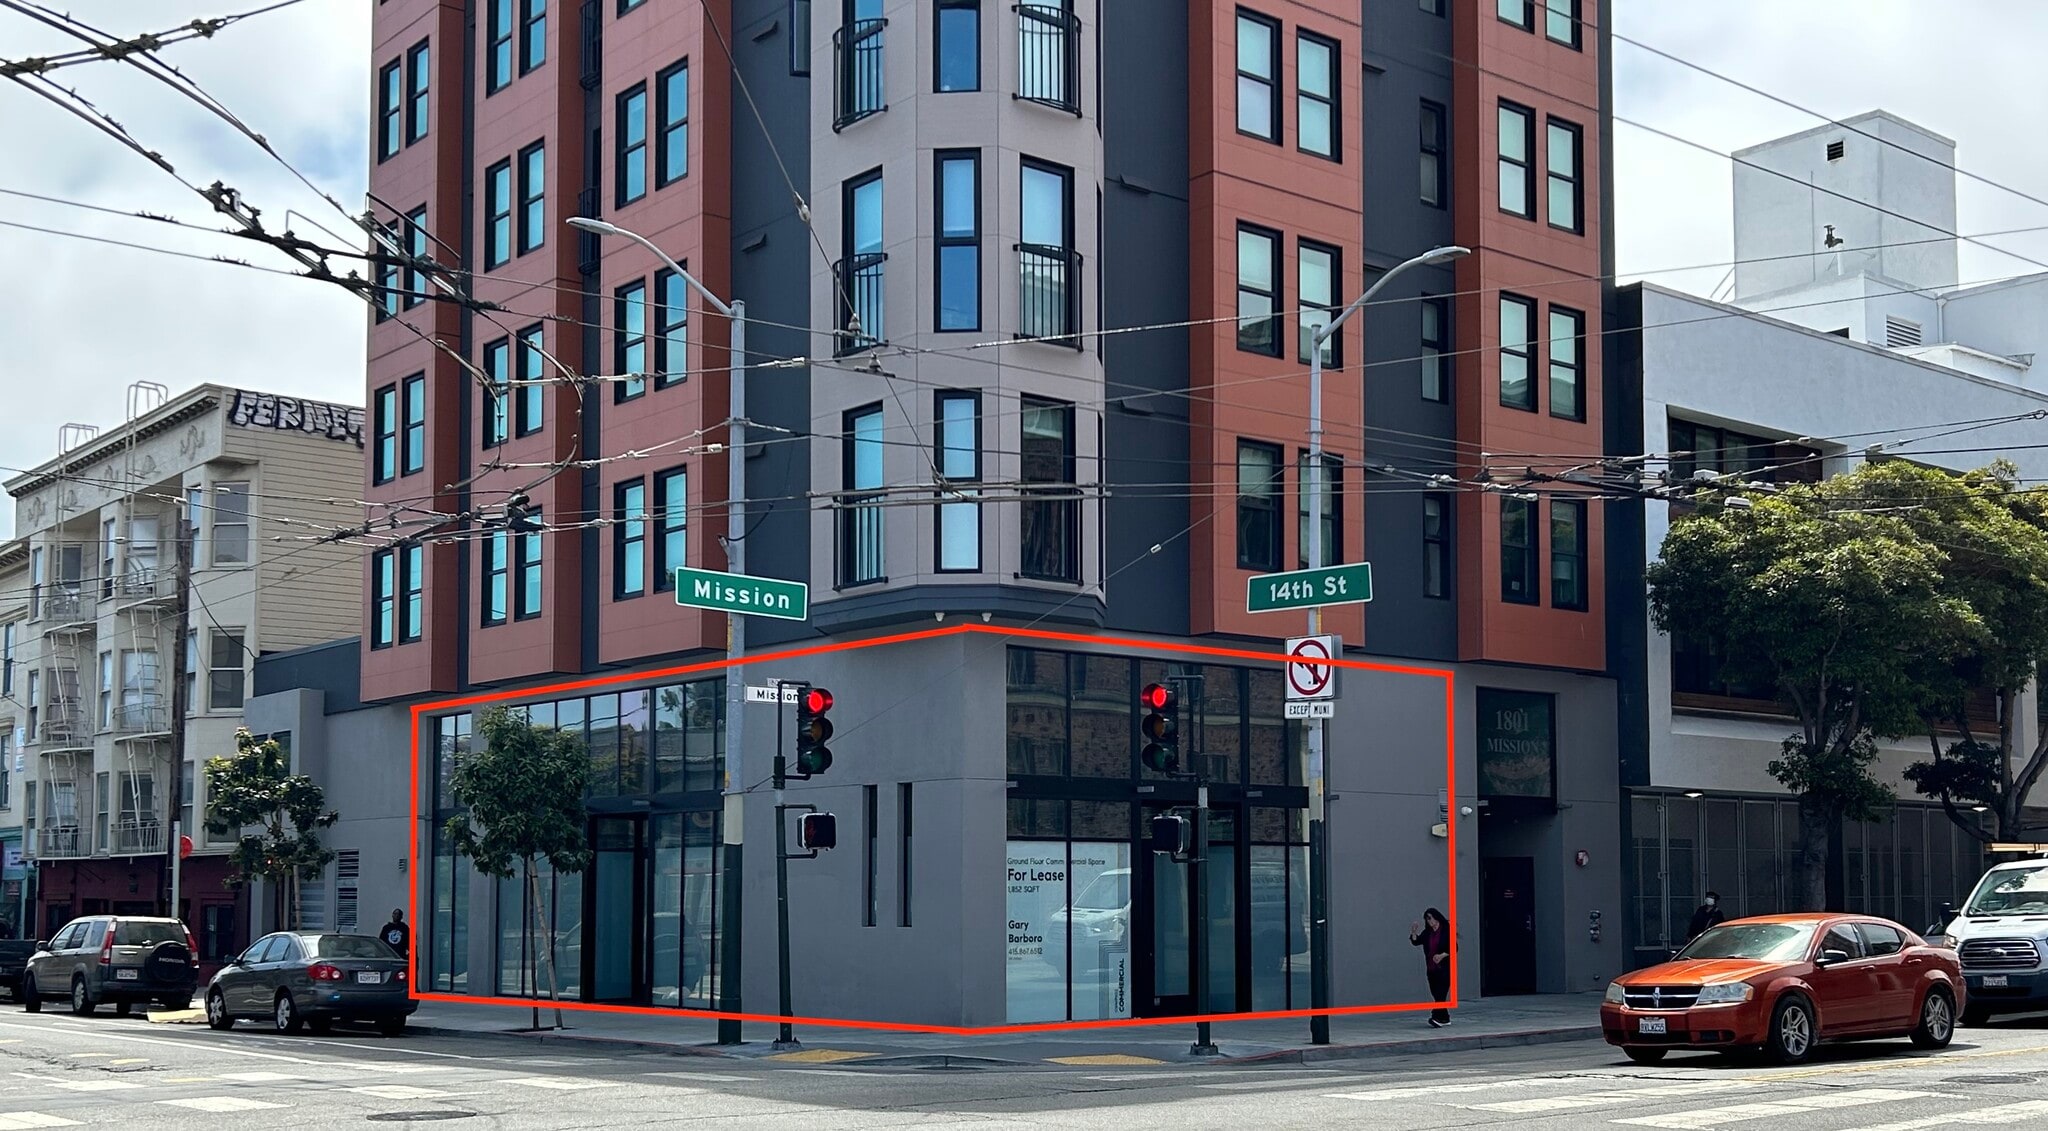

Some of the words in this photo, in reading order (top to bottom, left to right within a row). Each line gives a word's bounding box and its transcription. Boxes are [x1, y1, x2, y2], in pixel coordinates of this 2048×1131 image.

[694, 579, 790, 609] Mission
[1271, 580, 1313, 601] 14th
[1324, 575, 1347, 596] St
[1289, 705, 1311, 715] EXCEPT
[1314, 705, 1329, 714] MUNI
[1496, 709, 1528, 732] 1801
[1487, 738, 1539, 754] MISSION
[1008, 868, 1027, 881] For
[1030, 868, 1064, 881] Lease
[1008, 920, 1029, 931] Gary
[1008, 934, 1043, 943] Barboro
